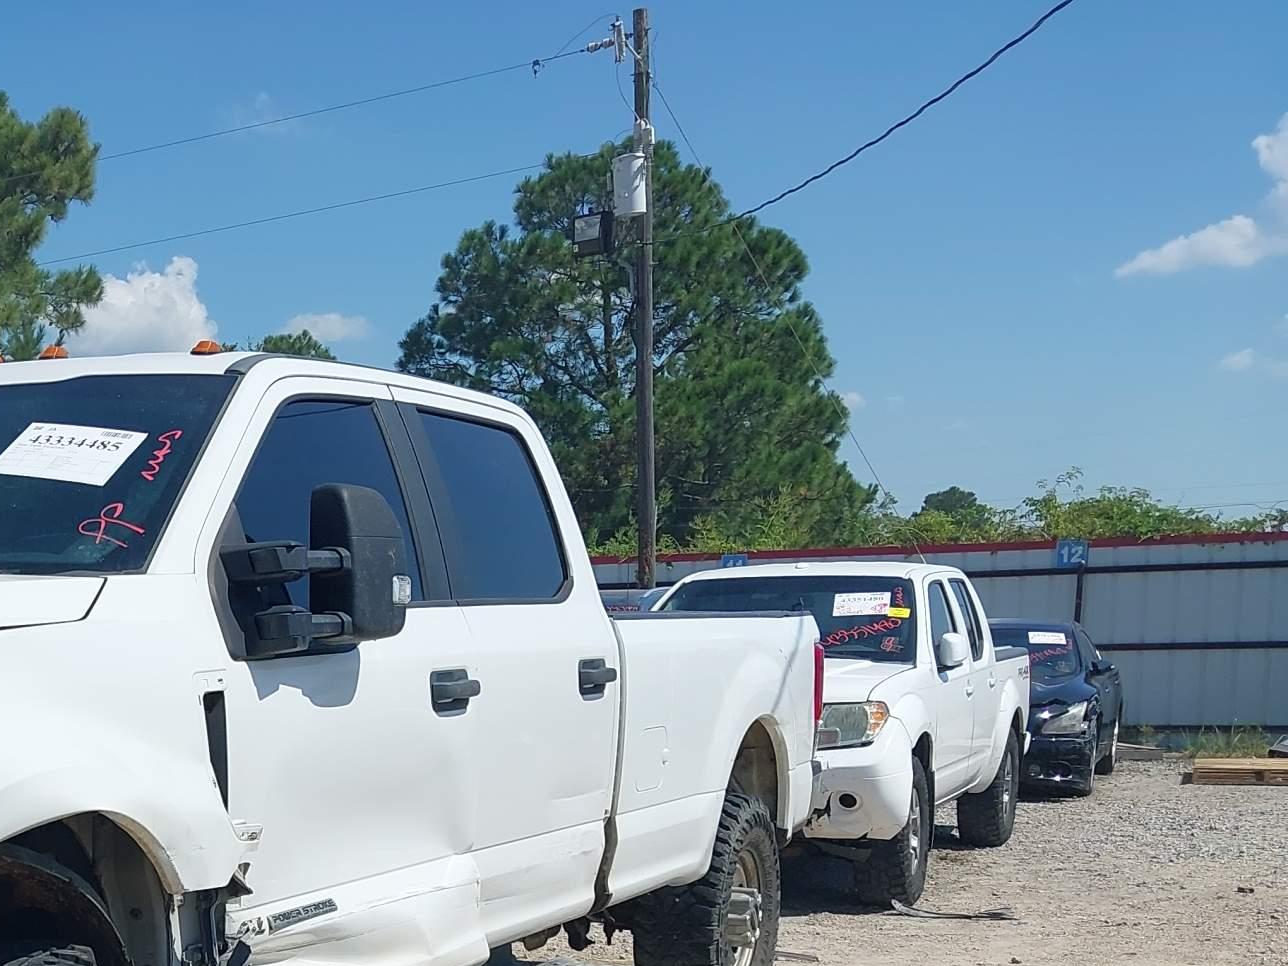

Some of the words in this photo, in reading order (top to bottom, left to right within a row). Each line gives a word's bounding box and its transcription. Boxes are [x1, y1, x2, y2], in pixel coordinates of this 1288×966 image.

[29, 435, 123, 452] 43334485
[1059, 545, 1082, 563] 12
[272, 908, 303, 924] POWER
[304, 898, 337, 915] STROKE
